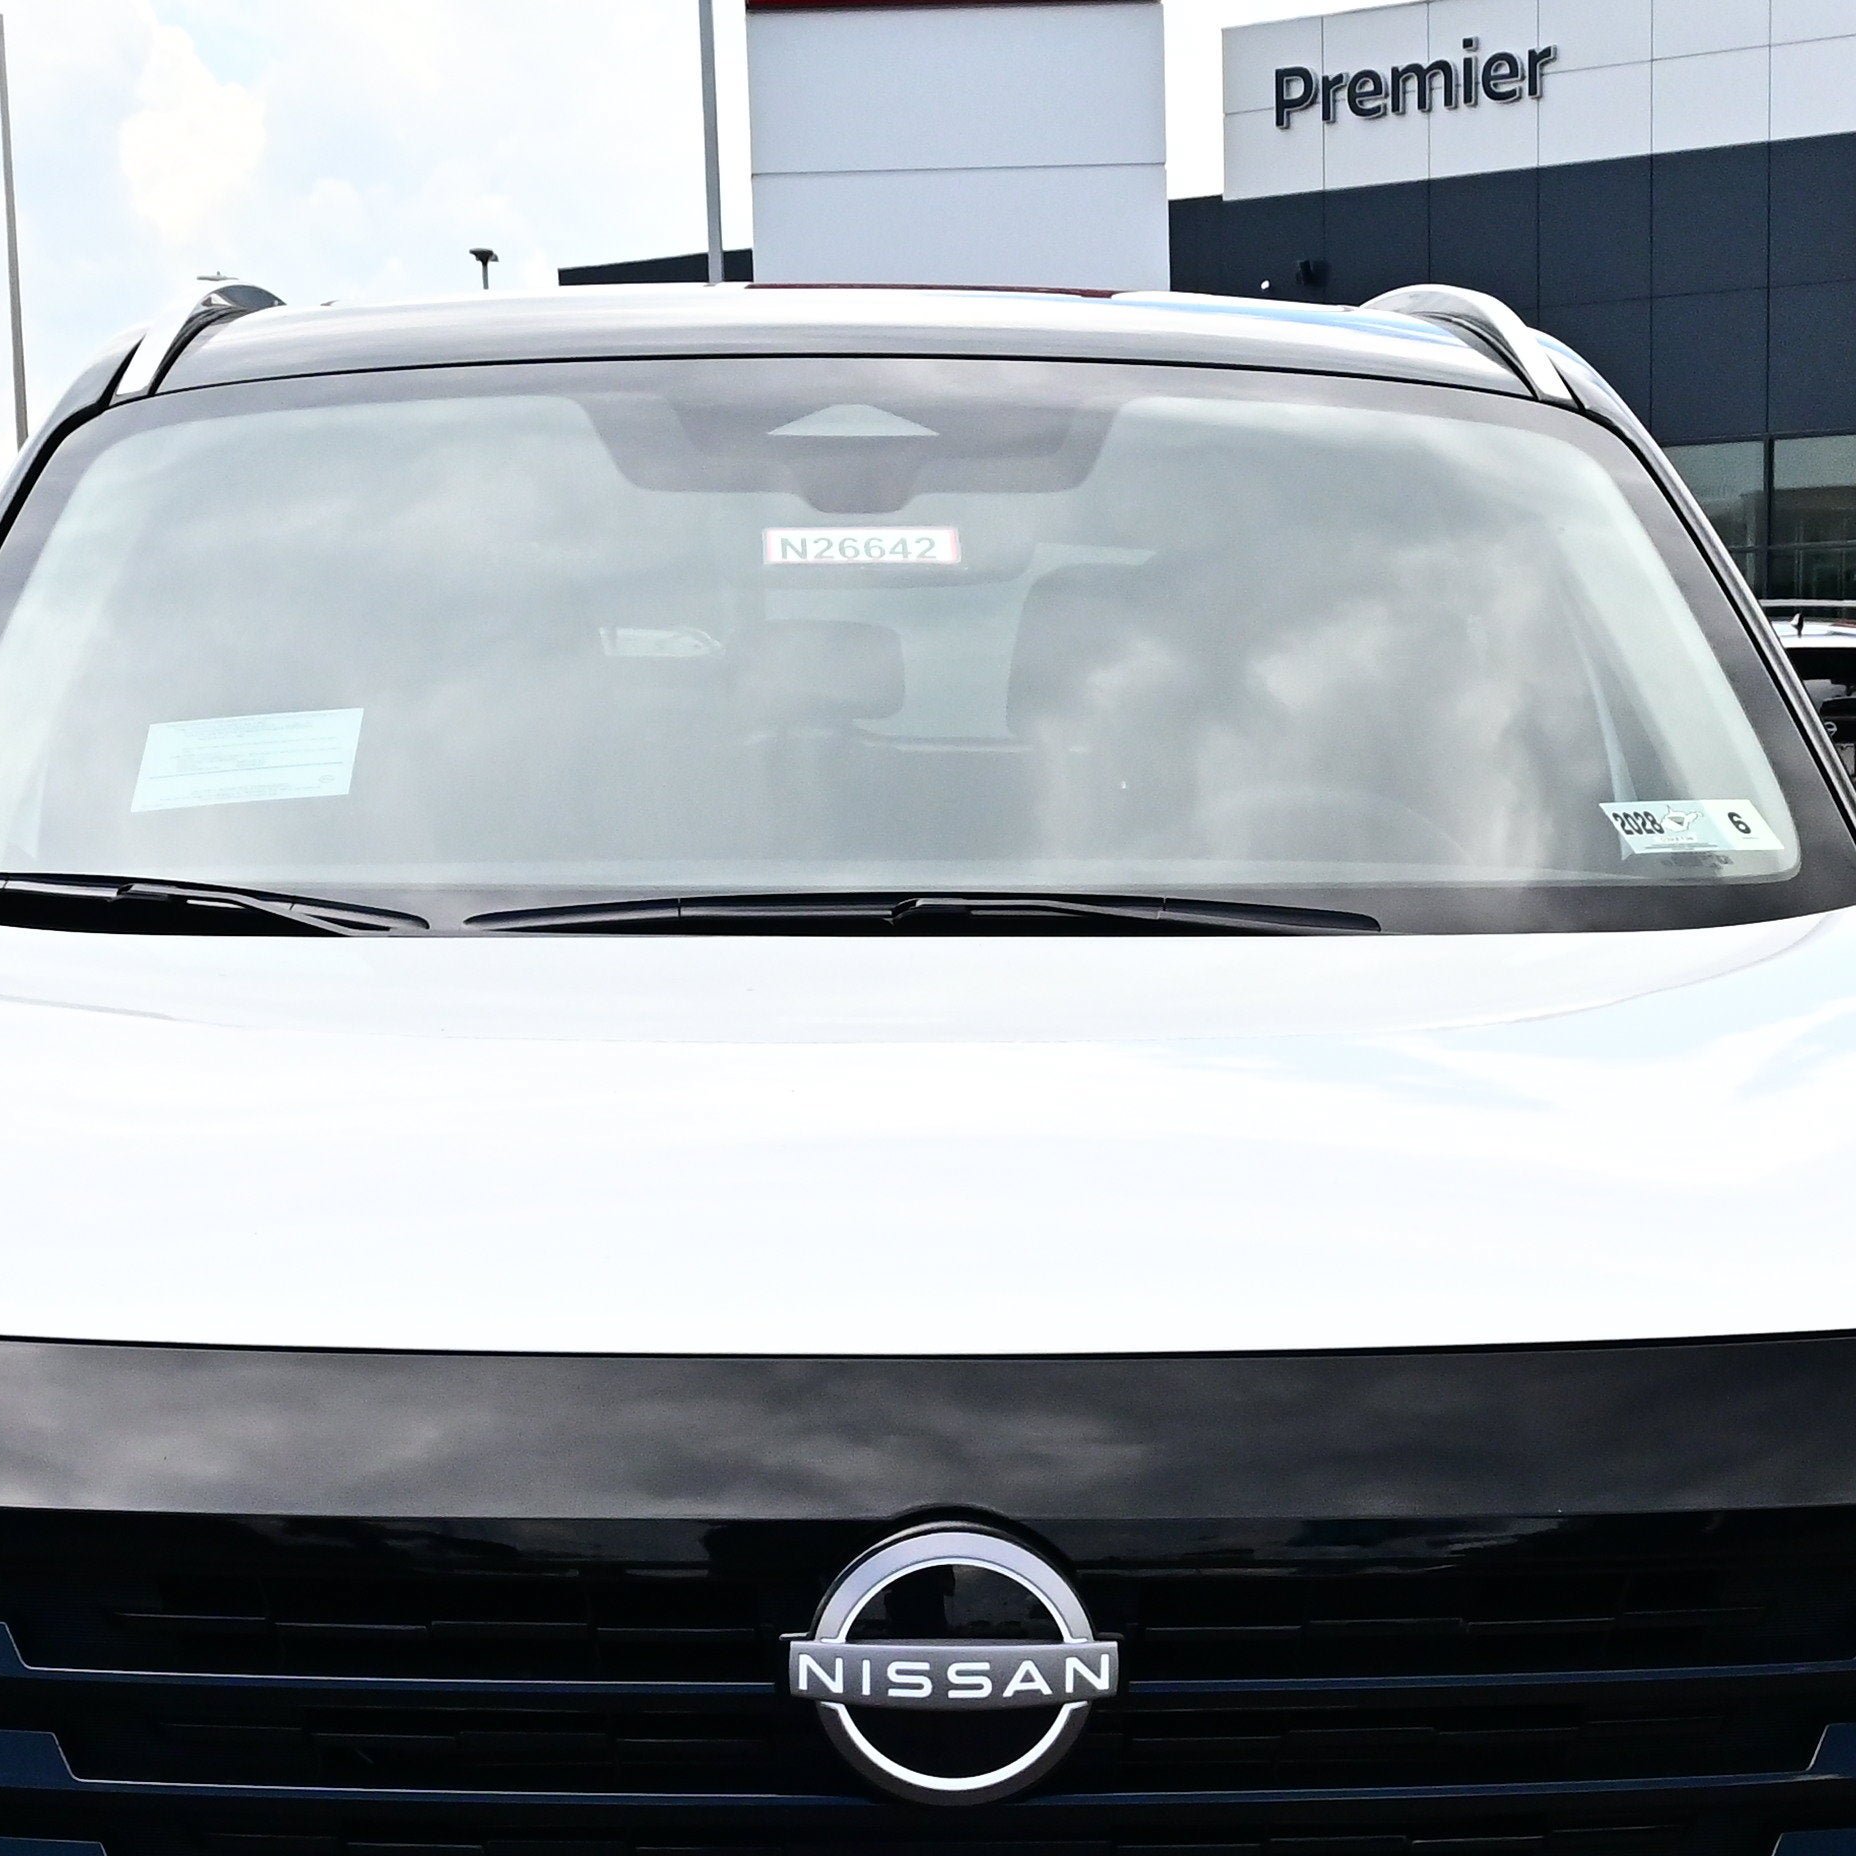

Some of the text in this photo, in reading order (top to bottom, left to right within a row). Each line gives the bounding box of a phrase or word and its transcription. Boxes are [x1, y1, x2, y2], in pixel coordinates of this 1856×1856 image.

[1275, 37, 1556, 127] Premier
[780, 537, 938, 560] N26642
[1612, 811, 1752, 836] 2028 6
[798, 1653, 1110, 1699] NISSAN
